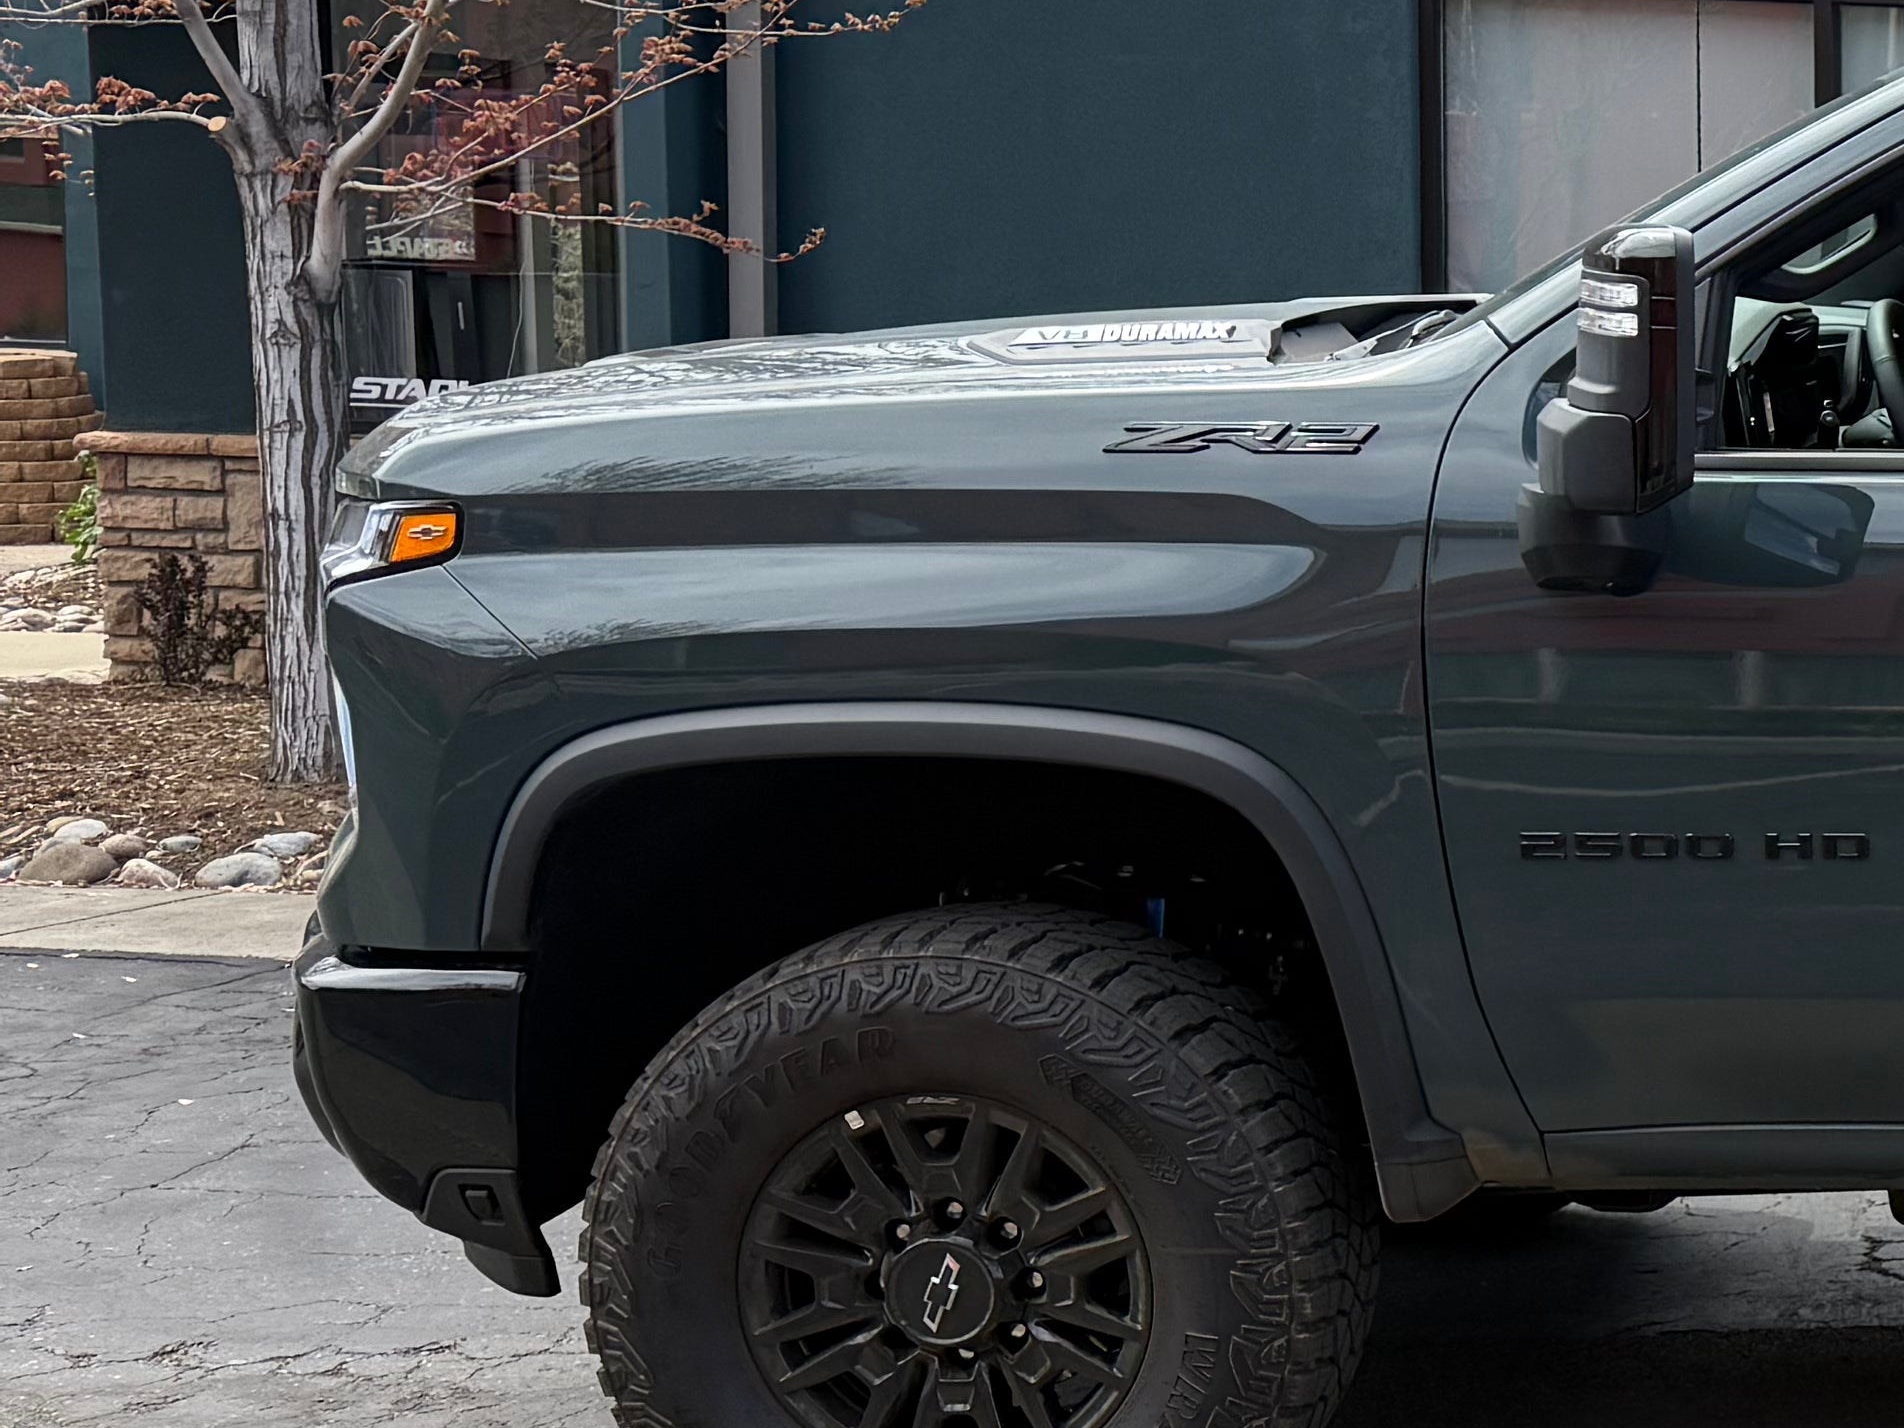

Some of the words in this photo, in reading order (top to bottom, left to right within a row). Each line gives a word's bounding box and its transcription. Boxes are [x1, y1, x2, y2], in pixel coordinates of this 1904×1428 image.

[1101, 322, 1237, 343] DURAMAX
[1102, 421, 1381, 455] ZR2
[1519, 831, 1735, 860] 2500
[1764, 831, 1870, 860] HD
